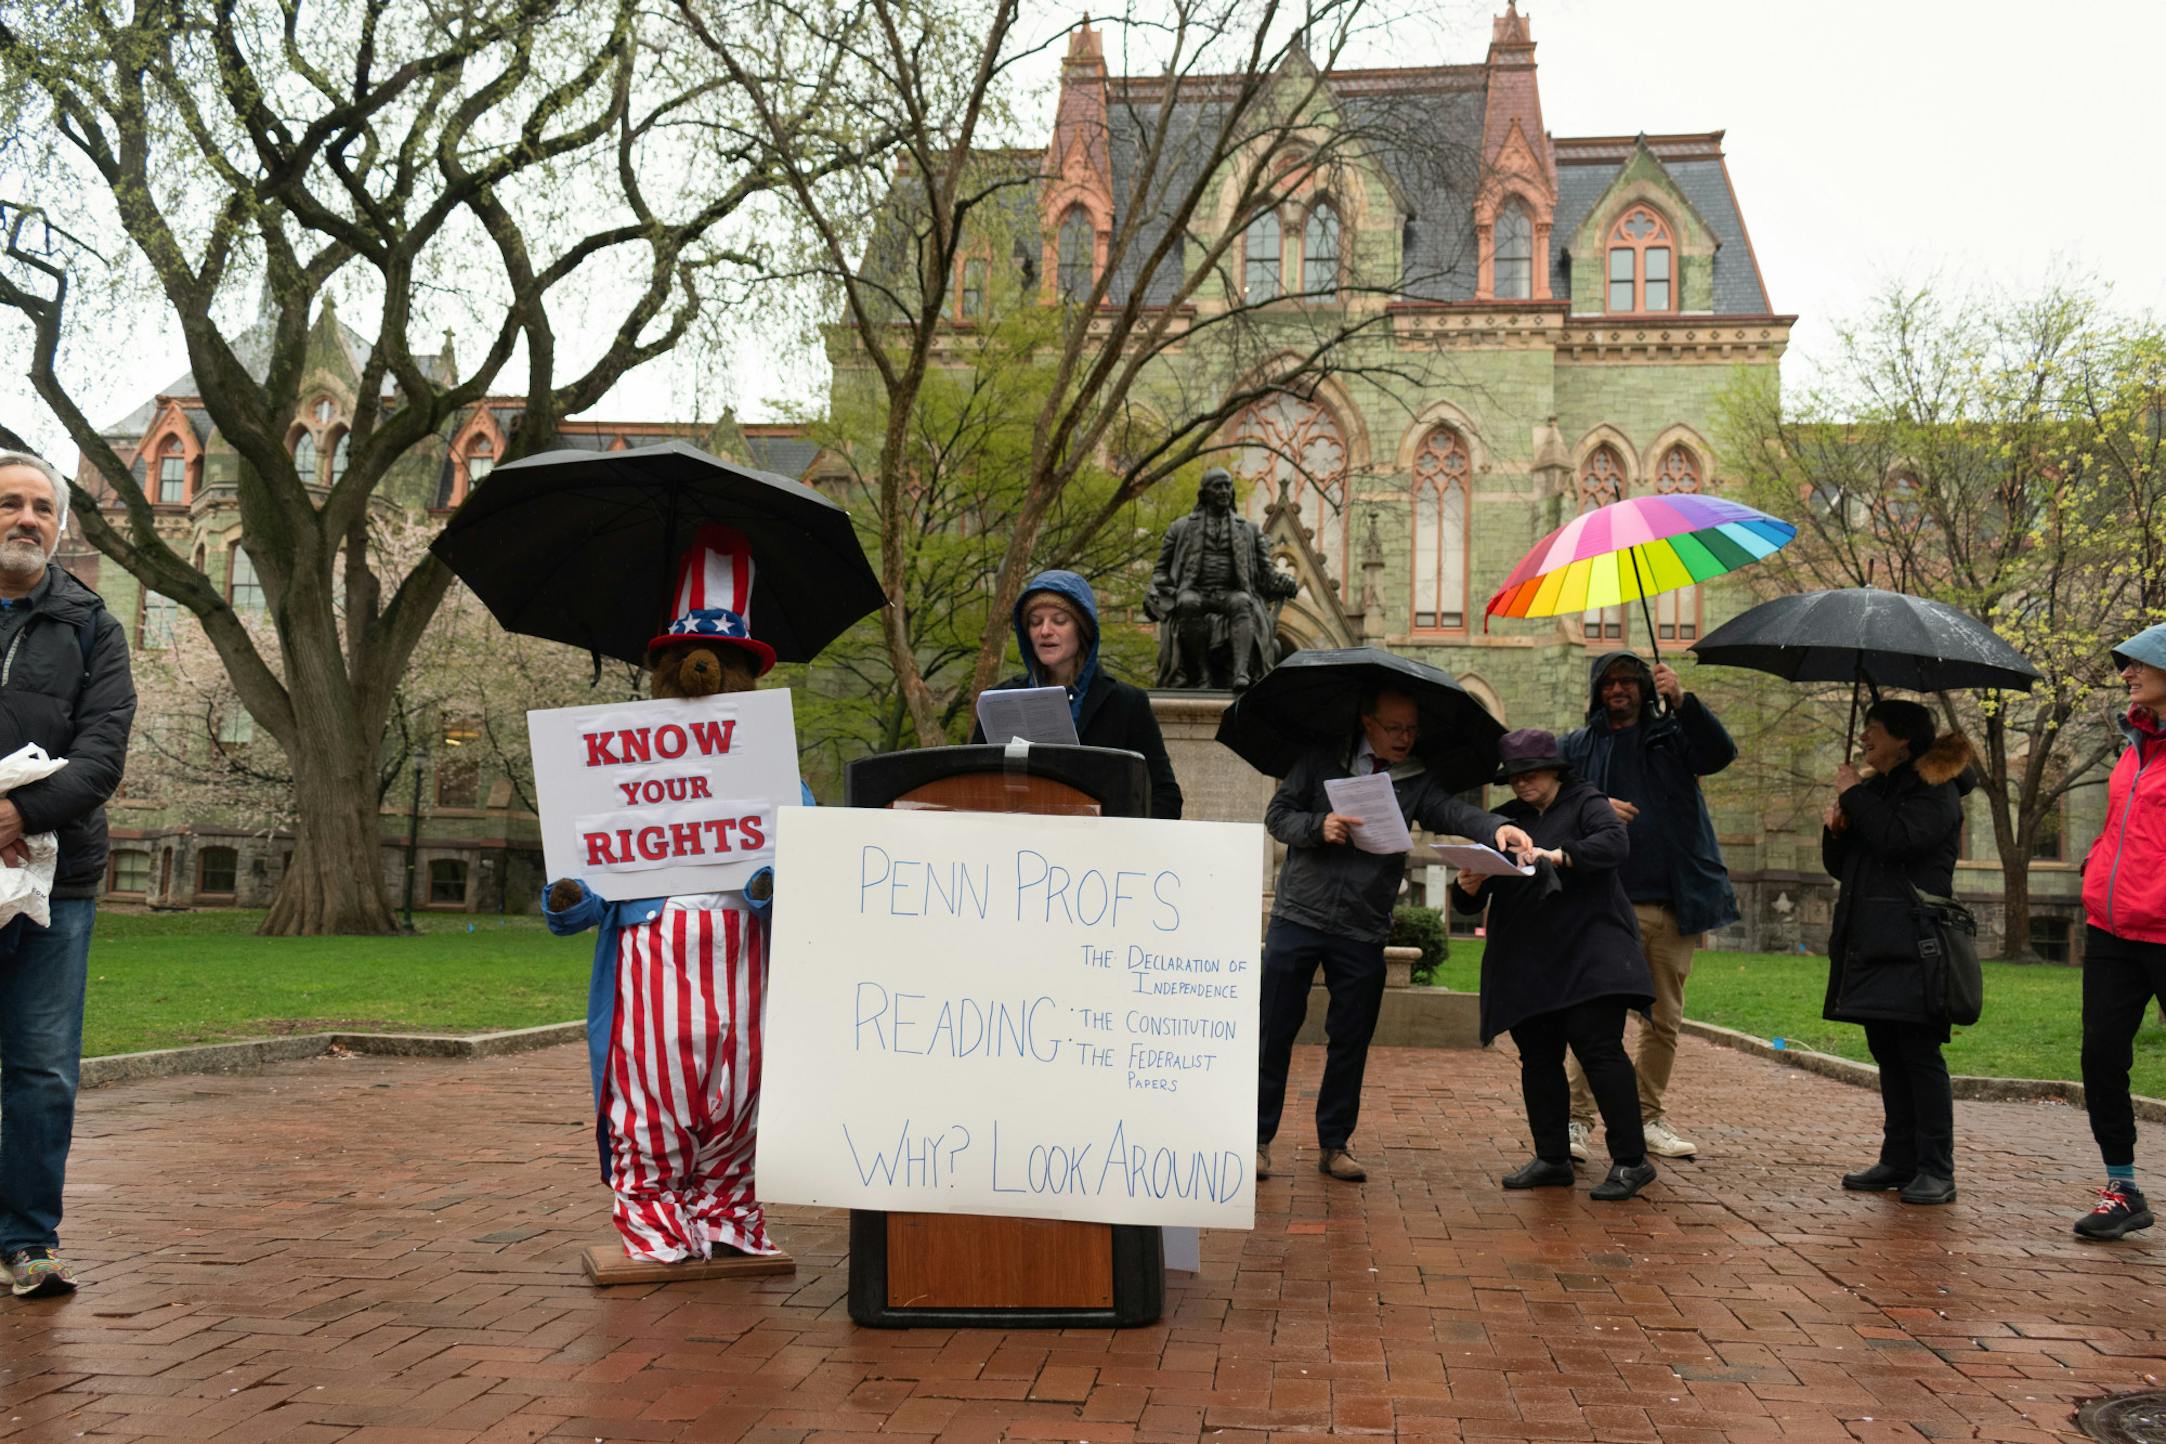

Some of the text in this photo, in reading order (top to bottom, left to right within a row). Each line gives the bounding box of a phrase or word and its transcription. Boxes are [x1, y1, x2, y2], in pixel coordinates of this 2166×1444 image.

[582, 719, 737, 768] KNOW
[619, 775, 713, 806] YOUR
[582, 815, 766, 866] RIGHTS
[860, 845, 1181, 932] PENN PROFS
[1080, 943, 1249, 973] THE DECLARATION OF
[1131, 970, 1239, 999] INDEPENDENCE
[1078, 1008, 1237, 1041] THE CONSTITUTION
[1076, 1042, 1217, 1071] THE FEDERALIST
[1127, 1070, 1178, 1093] PAPERS
[842, 1119, 1245, 1205] WHY? LOOK AROUND
